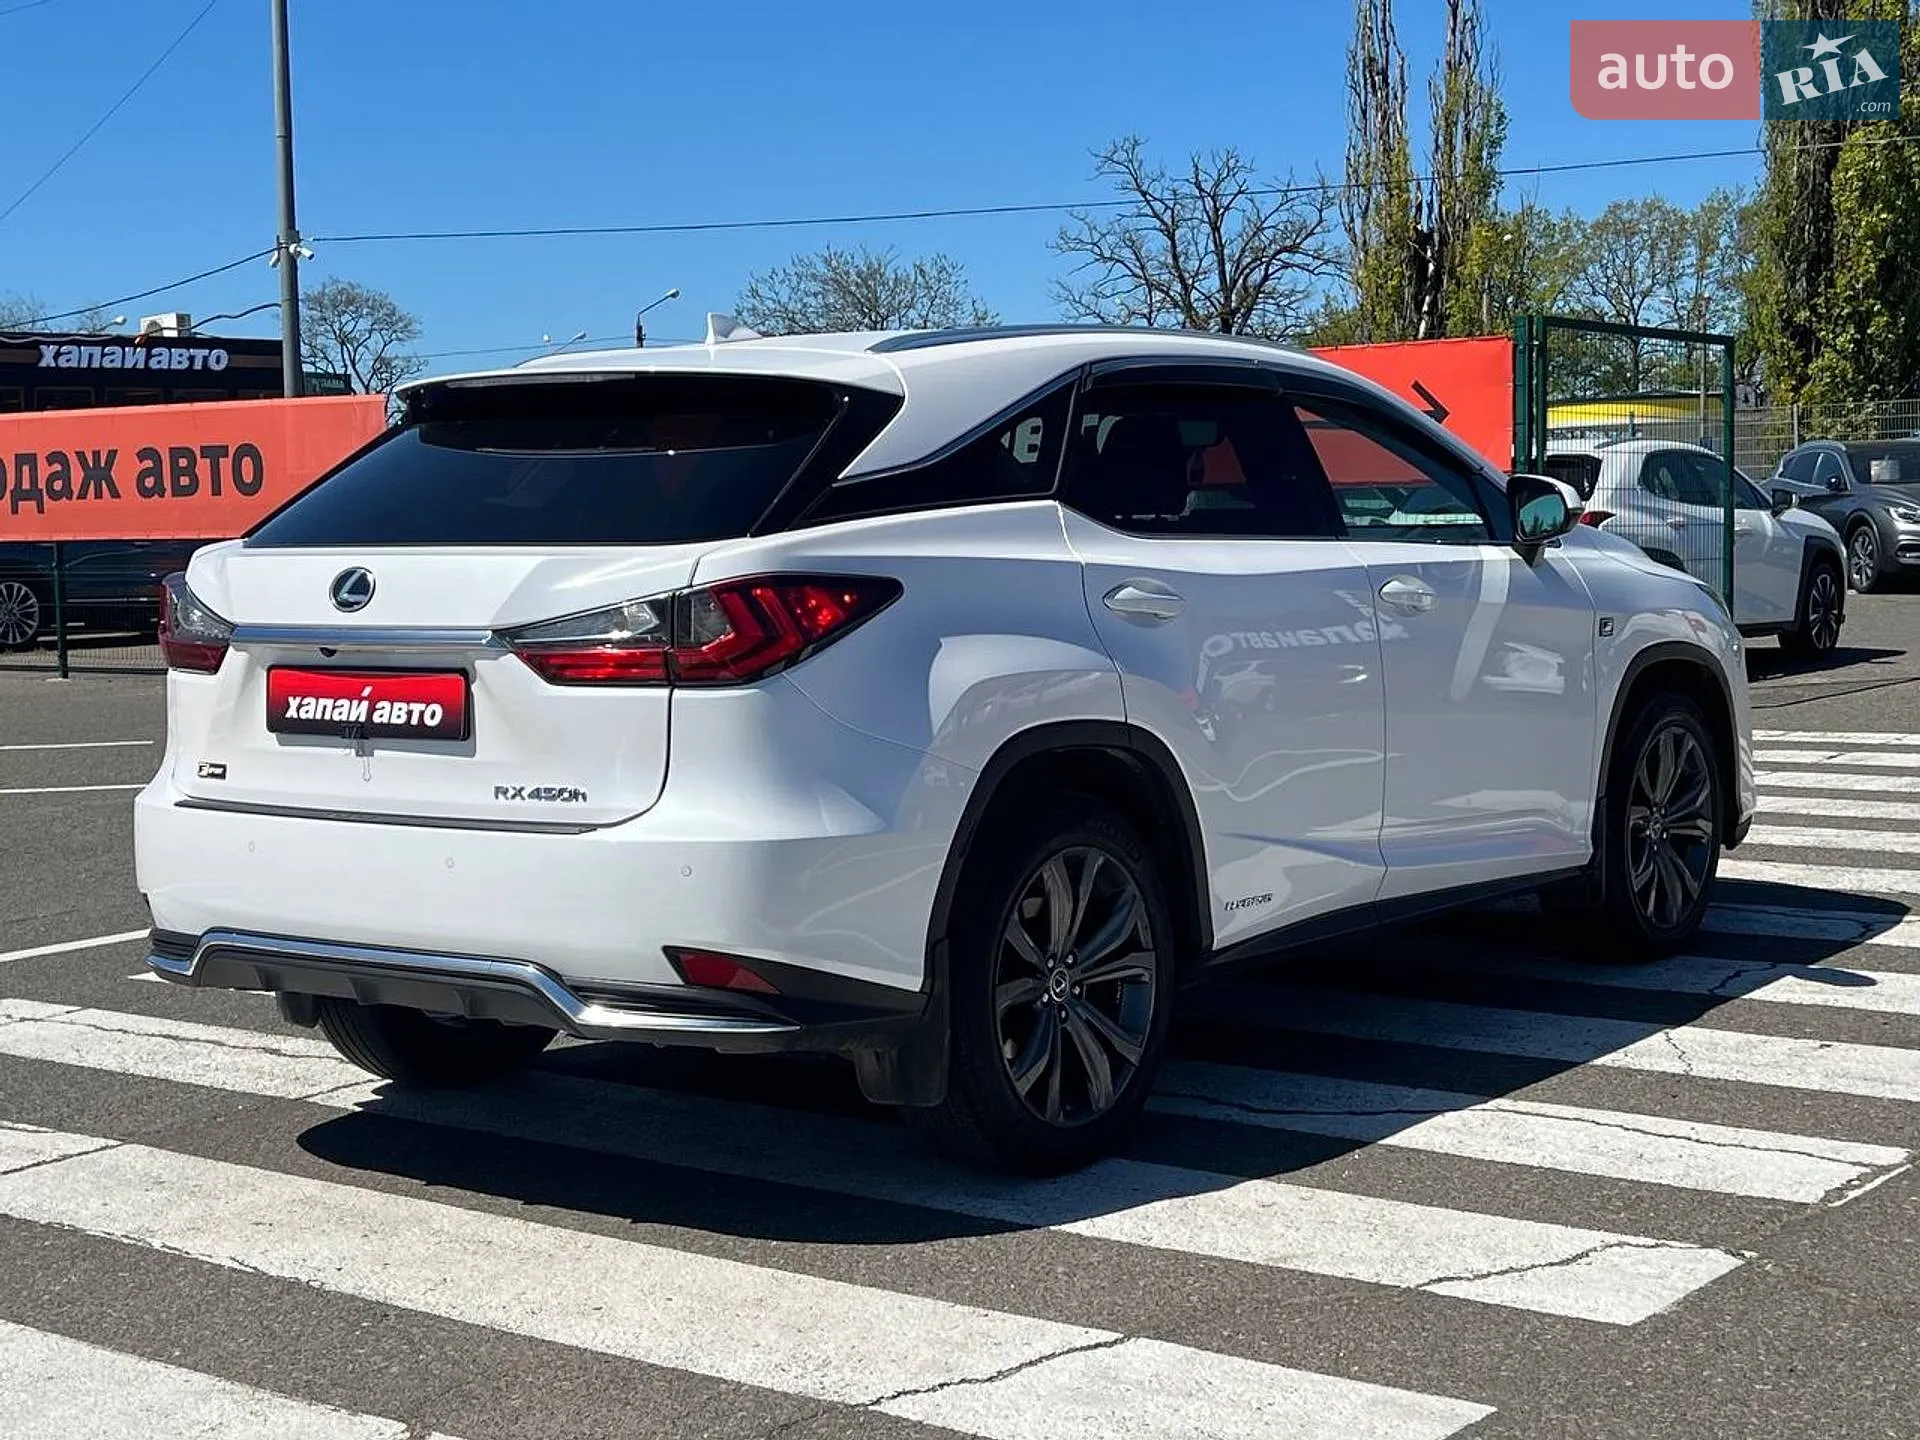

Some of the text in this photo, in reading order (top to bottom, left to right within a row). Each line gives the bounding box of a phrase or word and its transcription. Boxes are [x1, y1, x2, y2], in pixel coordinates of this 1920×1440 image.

[148, 347, 230, 371] авто
[0, 442, 264, 515] даж авто
[372, 699, 443, 728] авто
